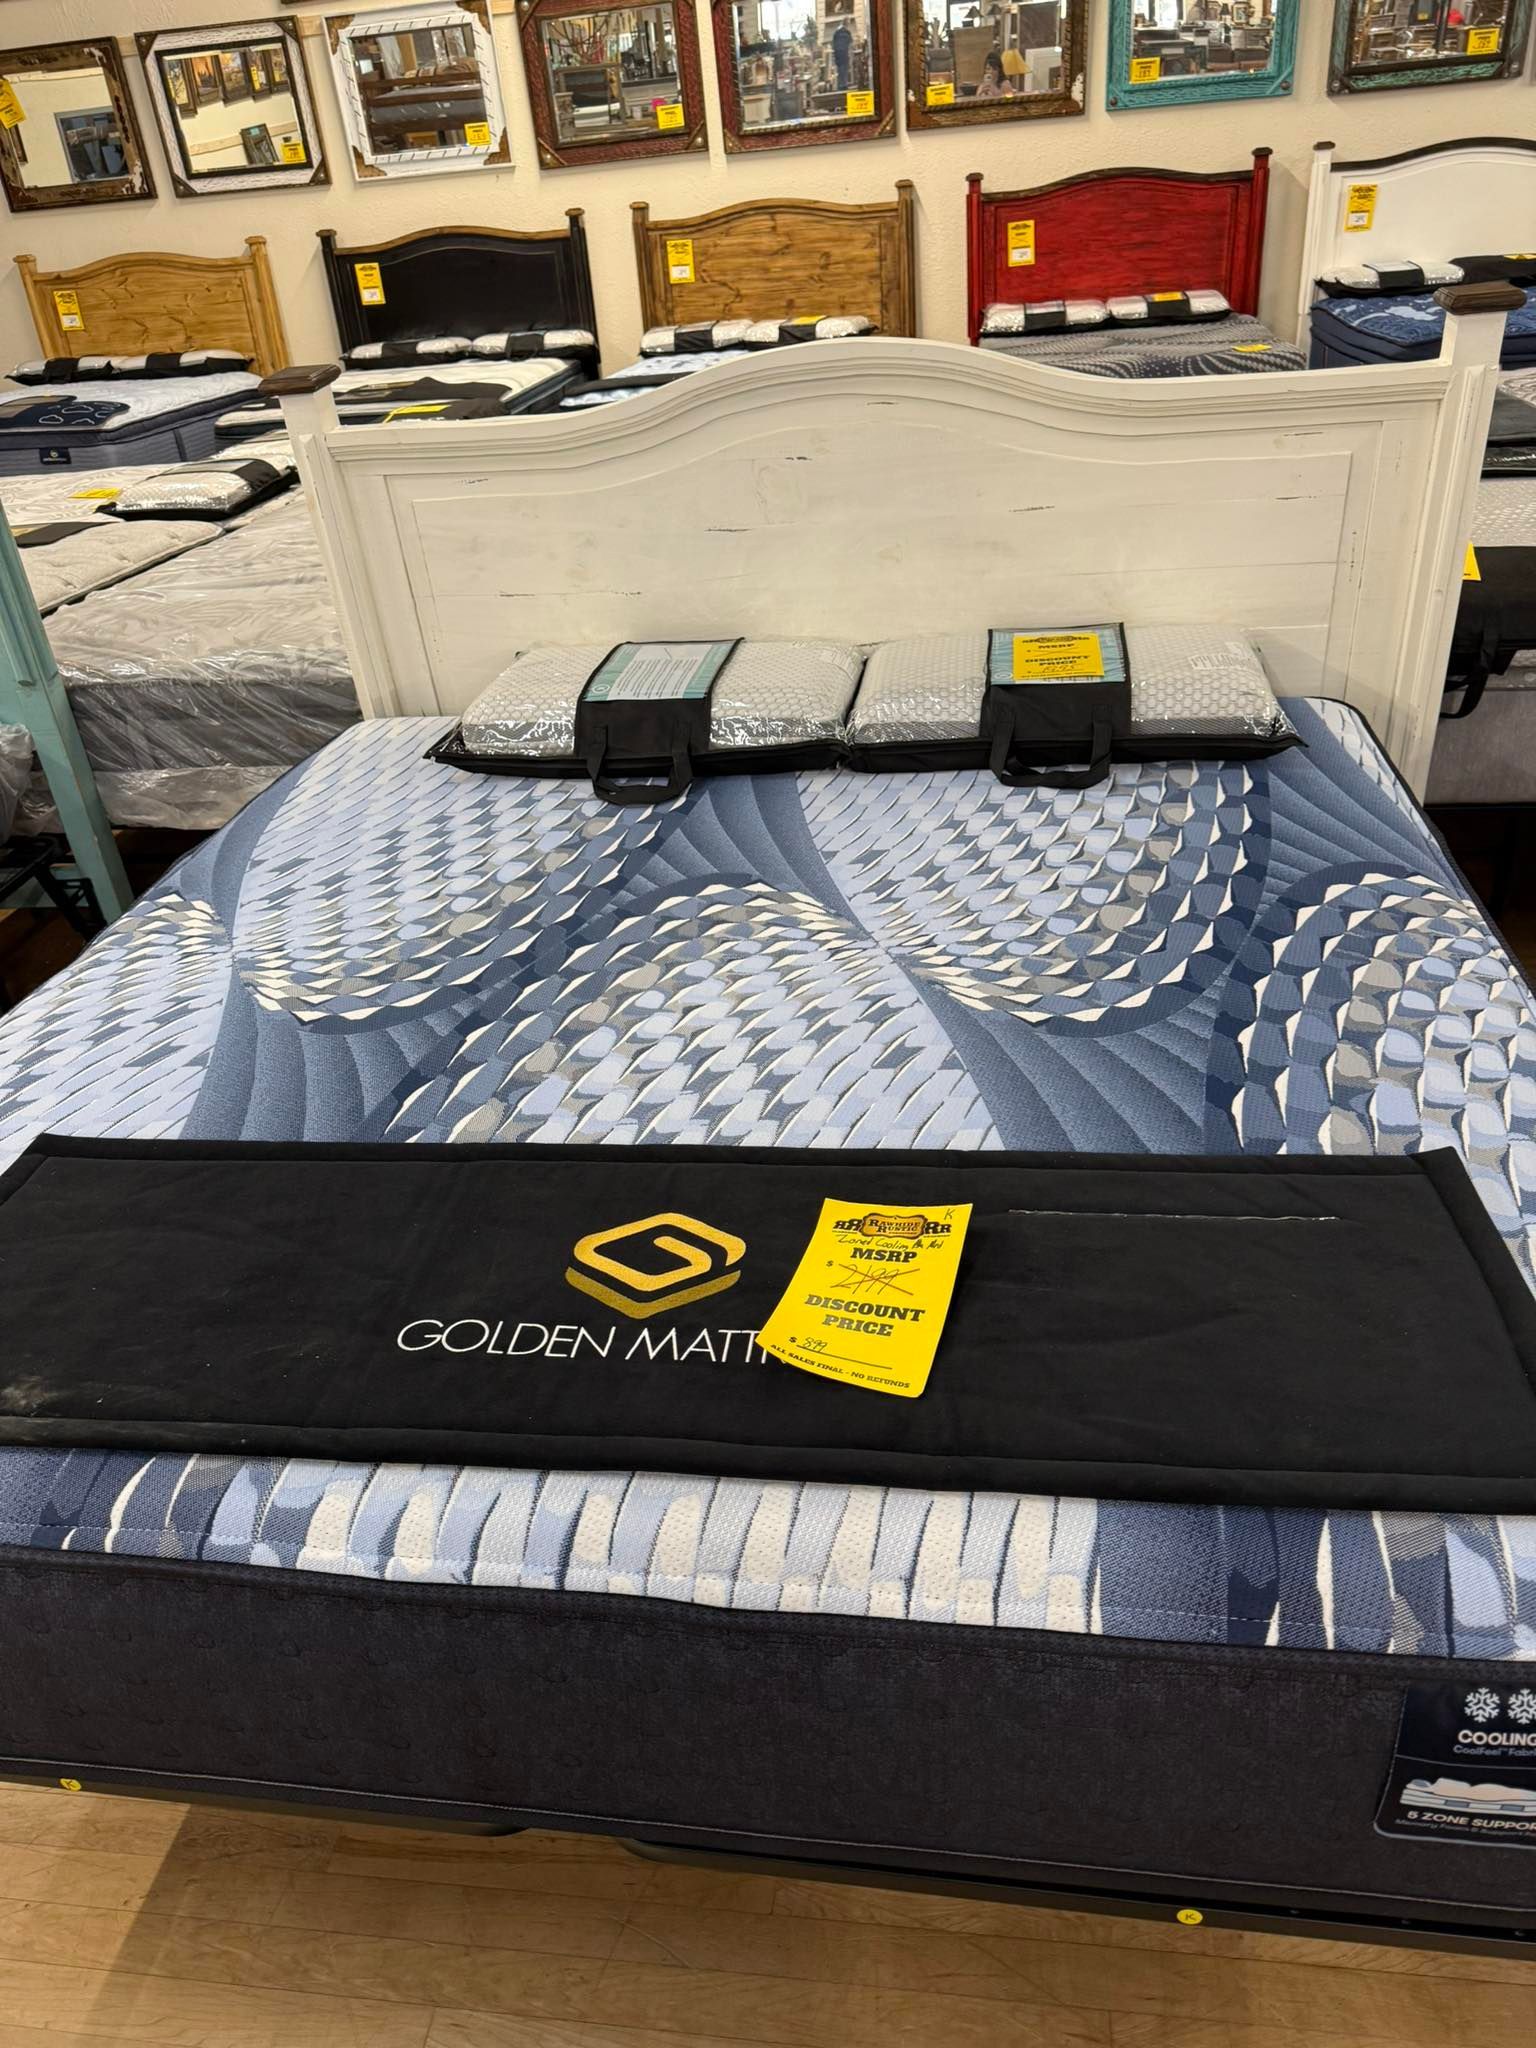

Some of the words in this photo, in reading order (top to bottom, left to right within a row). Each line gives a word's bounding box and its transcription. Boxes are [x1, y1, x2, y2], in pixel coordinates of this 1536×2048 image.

[869, 1218, 920, 1228] RAWHIDE
[849, 1247, 917, 1264] MSRP
[804, 1293, 926, 1322] DISCOUNT
[821, 1313, 895, 1337] PRICE
[396, 1317, 616, 1360] GOLDEN
[624, 1326, 772, 1366] MATT
[770, 1344, 787, 1356] ALL
[787, 1351, 816, 1367] SALES
[816, 1360, 844, 1375] FINAL
[851, 1370, 866, 1380] NO
[866, 1374, 911, 1389] REFUNDS
[1407, 1810, 1418, 1820] 5
[1421, 1812, 1469, 1826] ZONE
[1185, 1913, 1197, 1922] K
